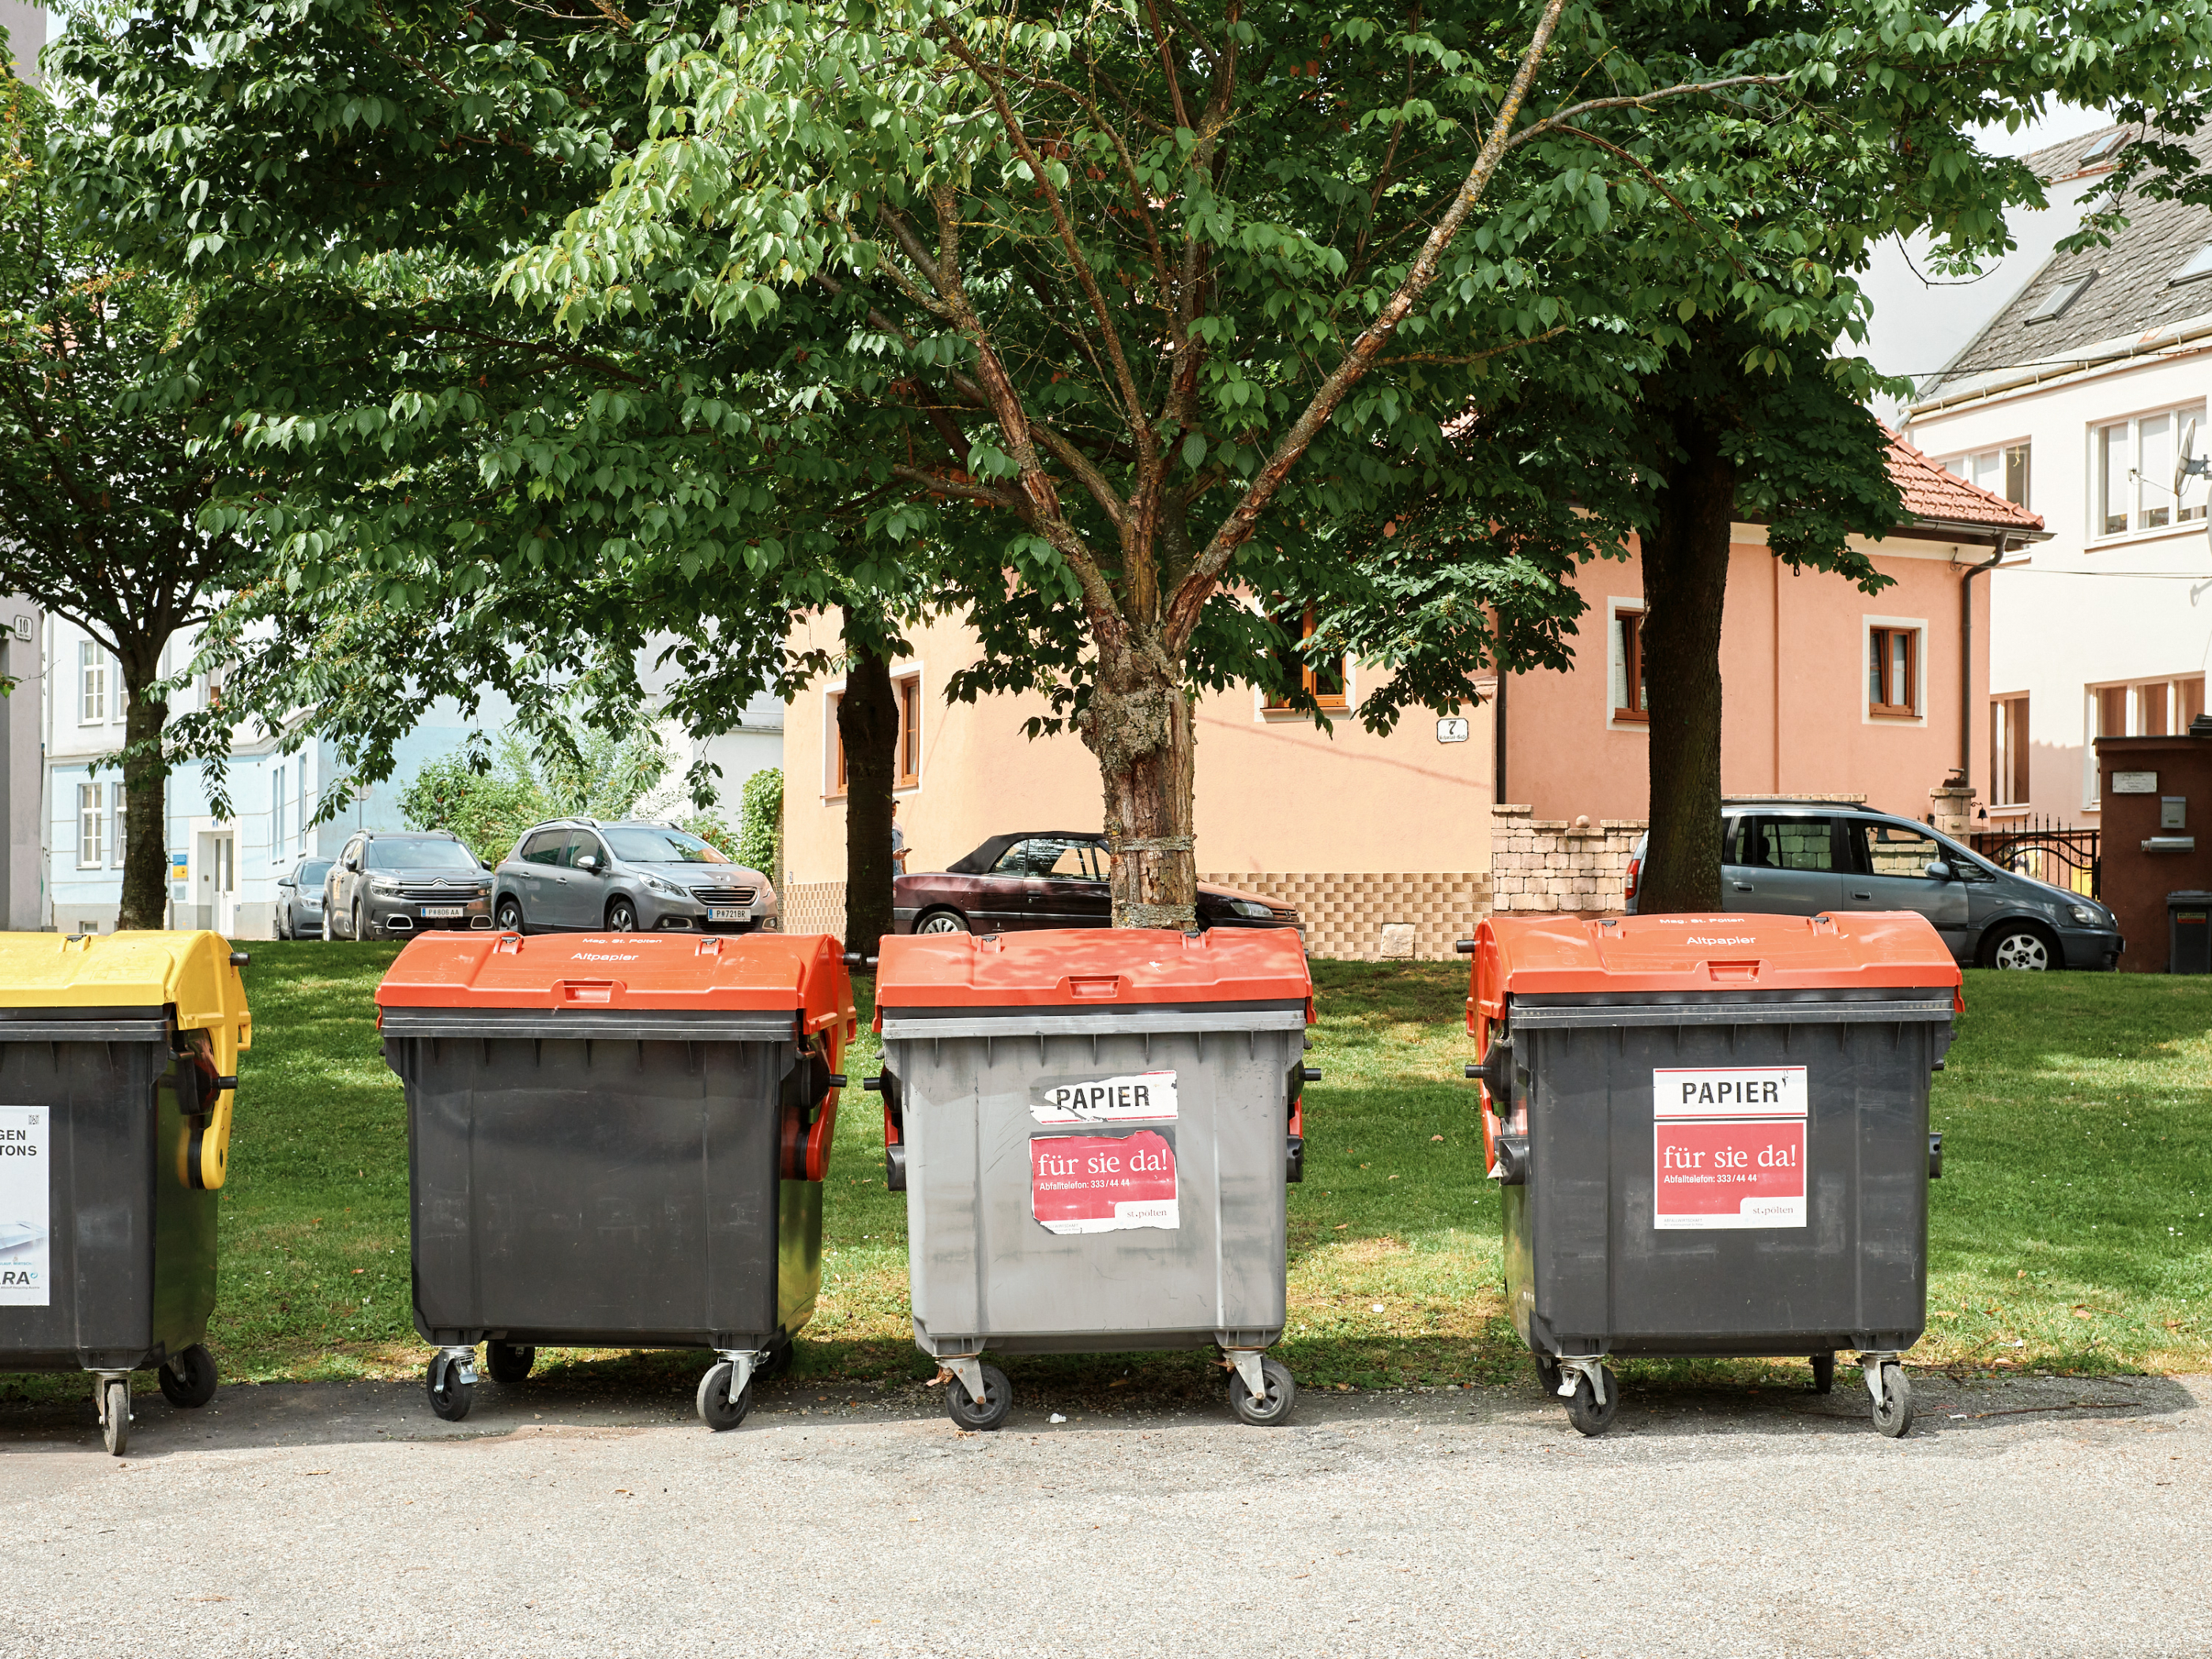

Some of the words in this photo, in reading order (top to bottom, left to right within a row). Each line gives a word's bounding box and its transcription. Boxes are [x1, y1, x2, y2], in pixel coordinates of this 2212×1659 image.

[20, 618, 28, 633] 10
[1448, 720, 1457, 735] 7
[1687, 936, 1756, 946] Altpapier
[571, 953, 638, 961] Altpapier
[1056, 1085, 1150, 1110] PAPIER
[1682, 1082, 1778, 1104] PAPIER
[1038, 1153, 1079, 1176] für
[1087, 1152, 1120, 1174] sie
[1130, 1149, 1167, 1172] da!
[1663, 1146, 1706, 1168] für
[1714, 1146, 1748, 1168] sie
[1757, 1144, 1796, 1167] da!
[1664, 1174, 1715, 1183] Abfalltelefon:
[1040, 1182, 1089, 1191] Abfalltelefon:
[1753, 1206, 1793, 1215] st.pölten
[0, 1271, 30, 1285] RA
